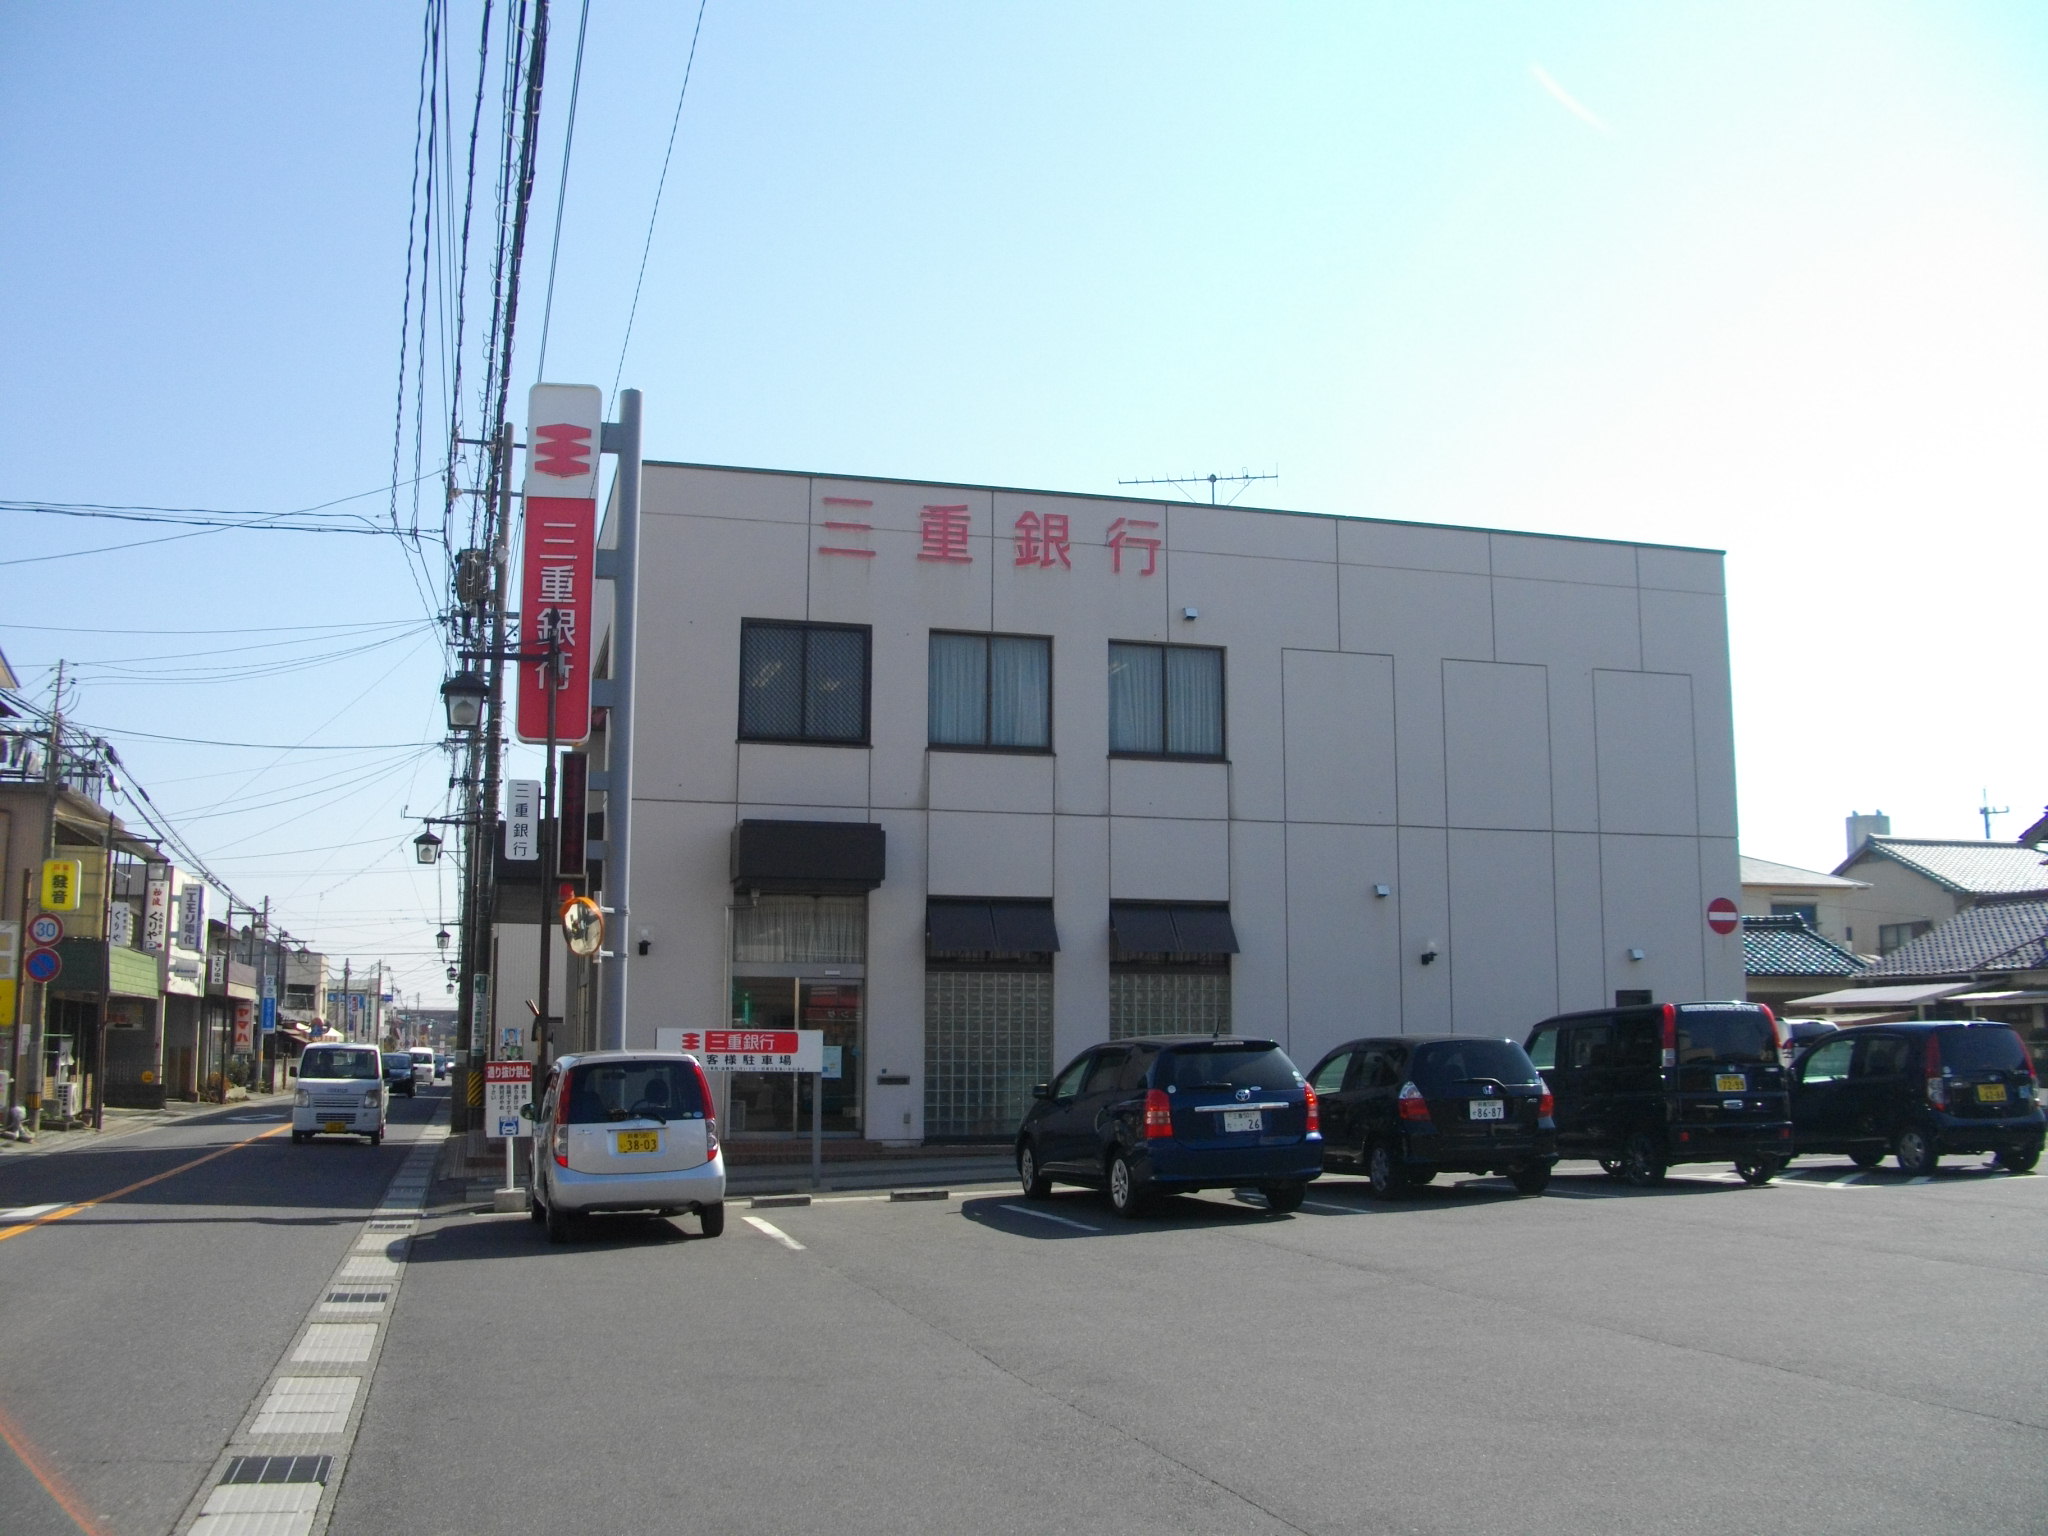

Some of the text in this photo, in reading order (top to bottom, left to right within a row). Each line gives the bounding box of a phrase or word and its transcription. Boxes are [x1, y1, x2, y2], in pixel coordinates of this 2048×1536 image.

[818, 497, 1162, 576] 三重銀行
[535, 522, 578, 692] 三重銀行
[512, 782, 530, 857] 三重銀行
[36, 922, 56, 938] 30
[146, 911, 158, 941] くりや
[237, 1007, 250, 1042] ヤマハ
[709, 1033, 775, 1051] 三重銀行
[487, 1065, 531, 1079] 通り抜け禁止
[693, 1054, 792, 1066] 客様駐車場
[626, 1139, 657, 1151] 38-03
